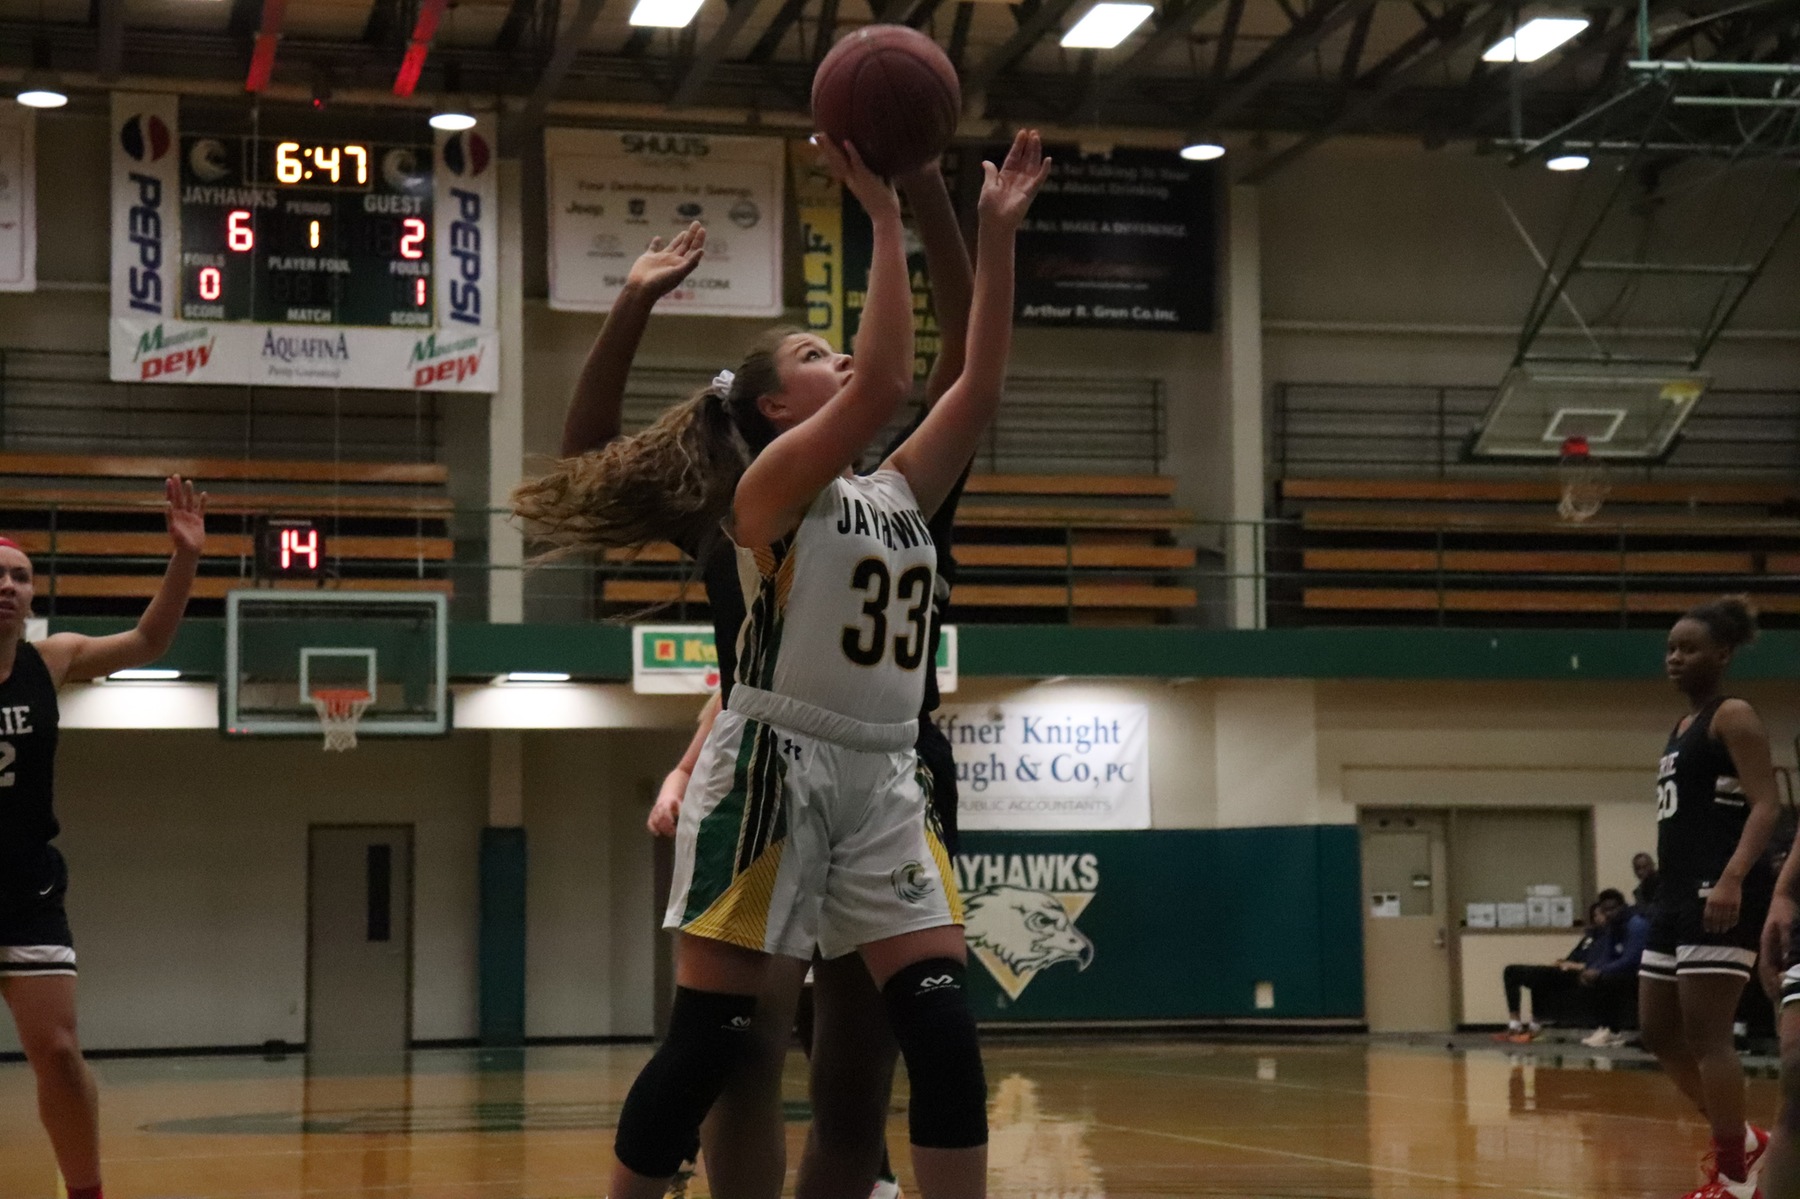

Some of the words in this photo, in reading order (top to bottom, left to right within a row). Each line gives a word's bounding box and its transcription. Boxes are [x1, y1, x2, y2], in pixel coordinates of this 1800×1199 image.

[276, 143, 367, 184] 6:47
[182, 186, 278, 209] JAYHAWKS
[363, 194, 423, 214] GUEST
[129, 171, 163, 314] PEPSI
[228, 211, 253, 251] 6
[310, 220, 320, 249] 1
[400, 218, 426, 258] 2
[268, 256, 317, 271] PLAYER
[450, 187, 482, 326] PEPSI
[200, 268, 220, 300] 0
[416, 278, 426, 306] 1
[184, 304, 225, 318] SCORE
[287, 308, 332, 323] MATCH
[390, 311, 430, 325] SCORE
[1023, 304, 1073, 317] Arthur
[281, 529, 317, 569] 14
[841, 557, 932, 670] 33
[936, 714, 1005, 744] ffner
[1022, 716, 1121, 754] Knight
[955, 753, 1007, 792] ugh
[1015, 755, 1042, 783] &
[1051, 753, 1099, 788] Co,
[1106, 763, 1134, 783] PC
[1009, 799, 1111, 813] ACCOUNTANTS
[953, 853, 1099, 891] YHAWKS
